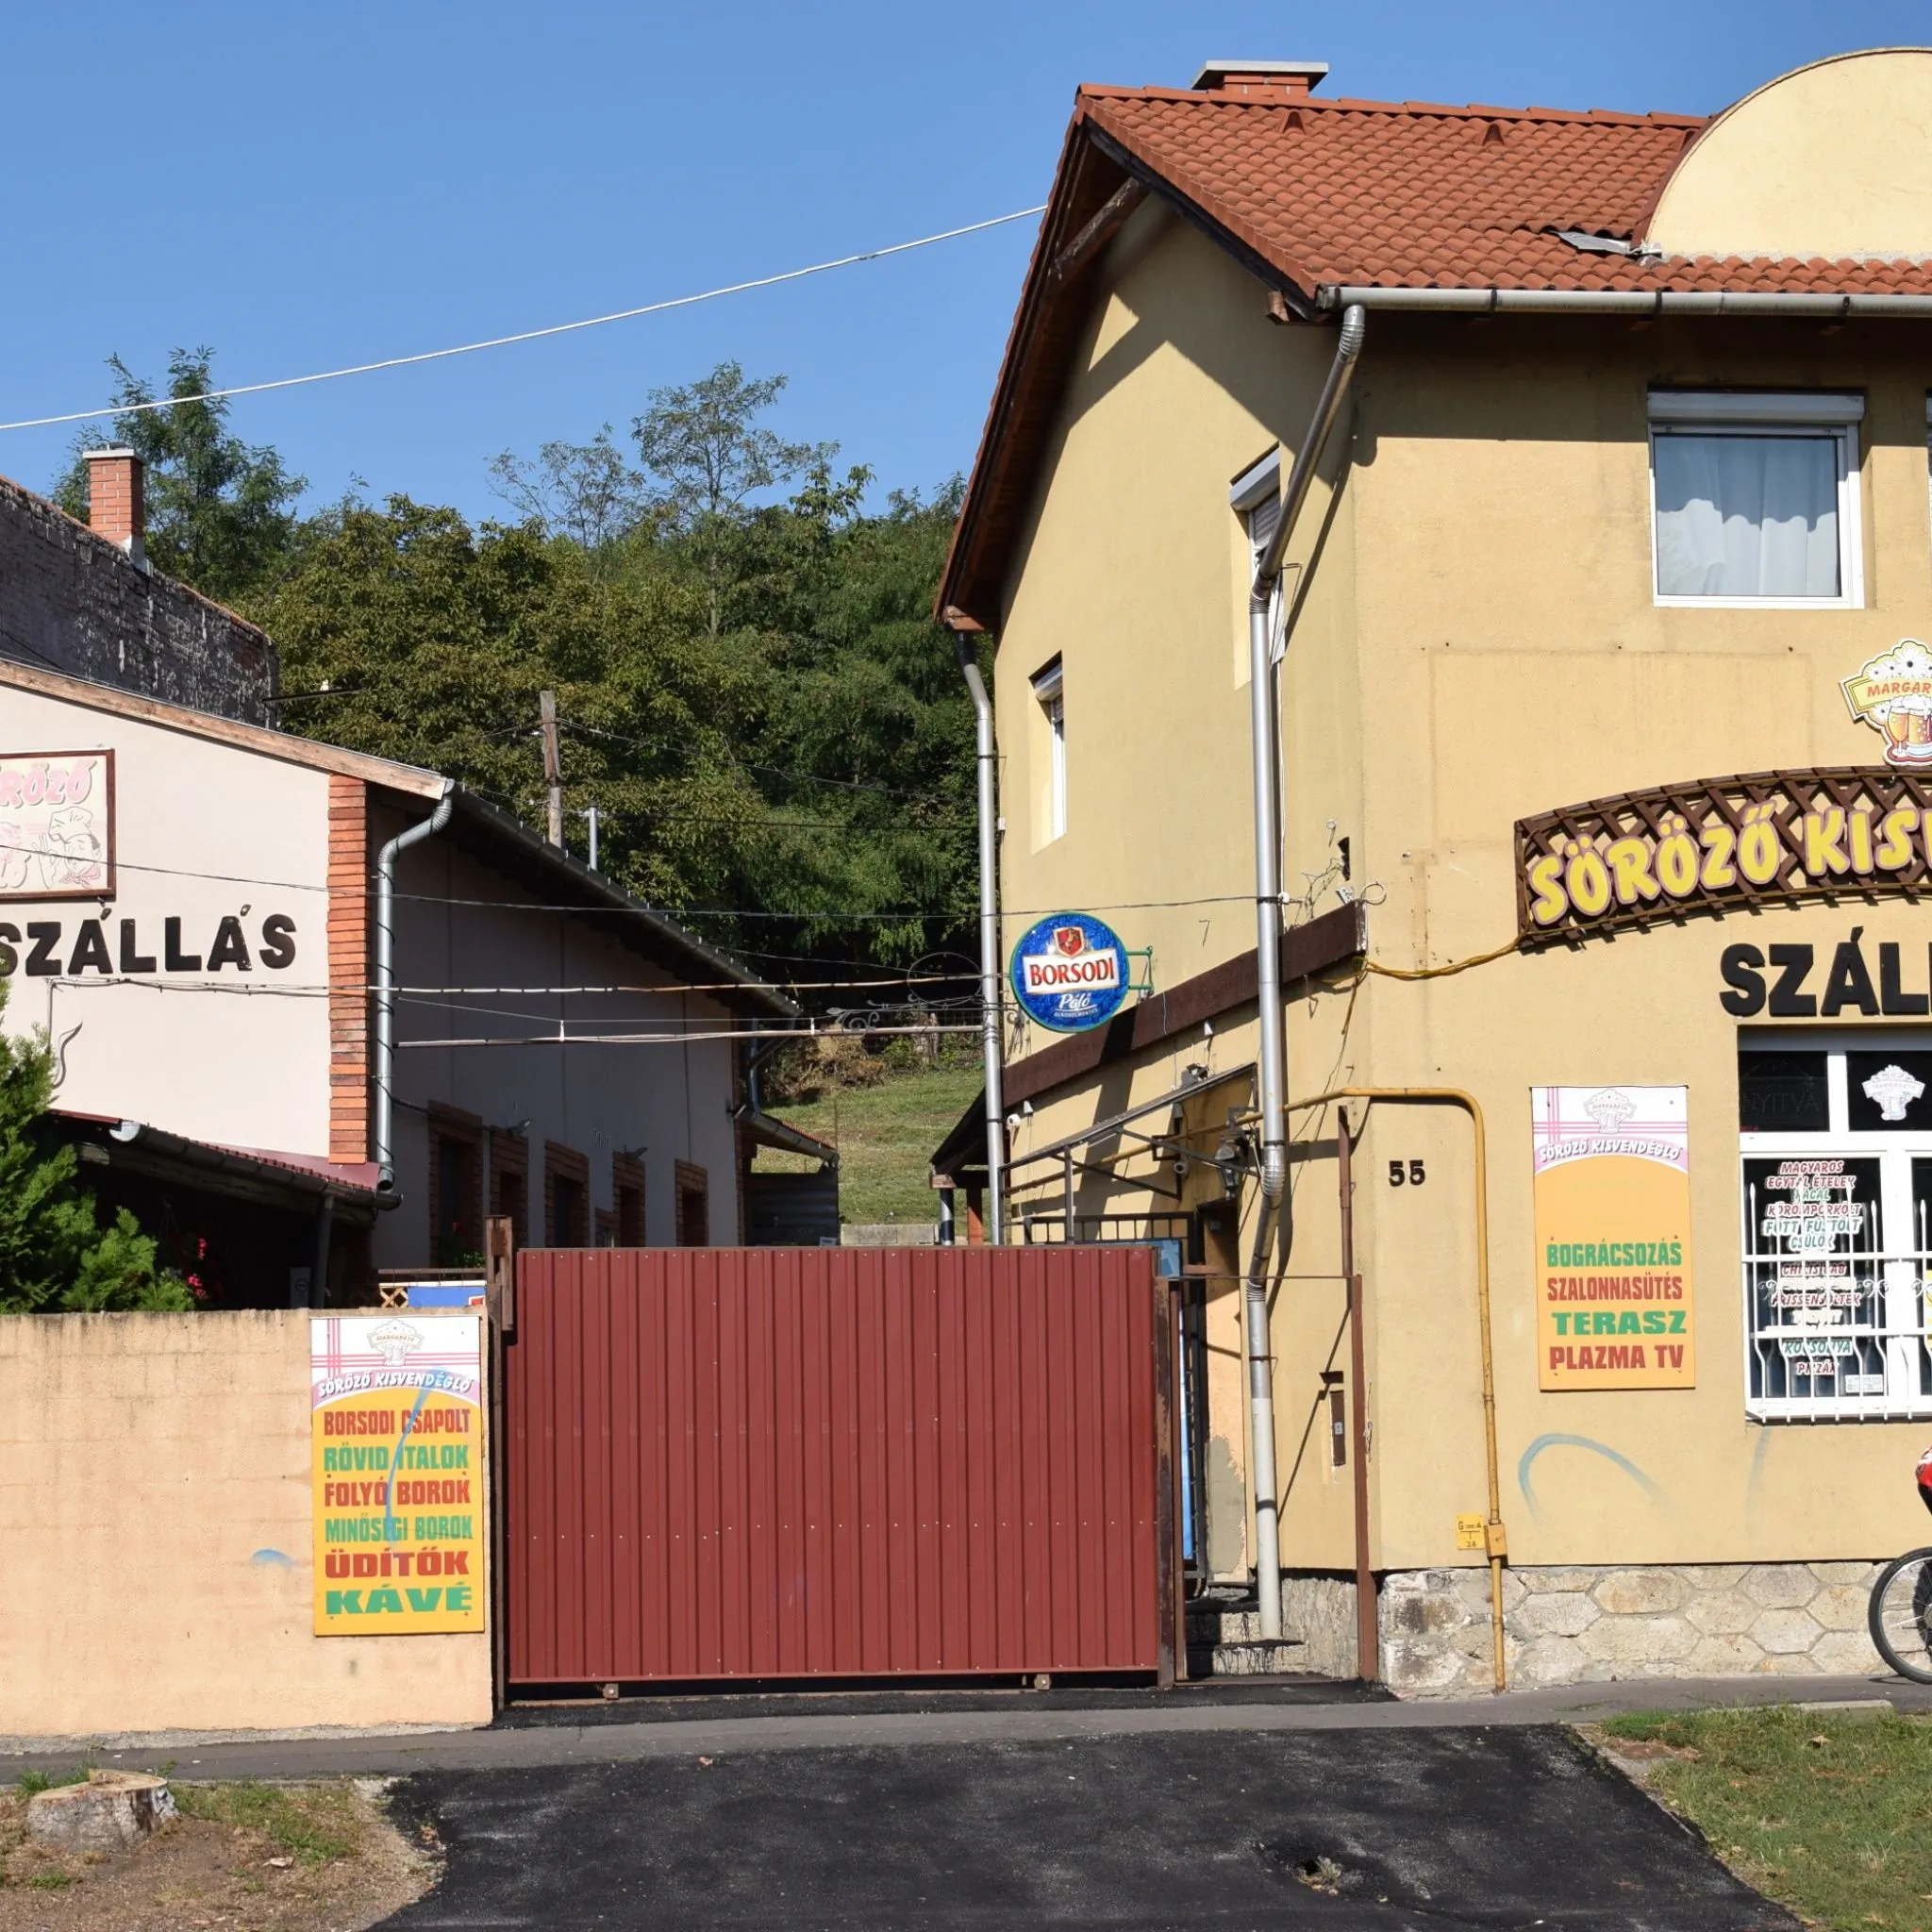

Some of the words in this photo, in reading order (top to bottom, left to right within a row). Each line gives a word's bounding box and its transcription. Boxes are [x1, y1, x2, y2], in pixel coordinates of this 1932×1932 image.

[1527, 799, 1780, 925] SÖRÖZŐ
[1803, 805, 1932, 877] KIS
[0, 904, 297, 976] SZÁLLÁS
[1029, 958, 1115, 987] BORSODI
[1719, 926, 1932, 1018] SZÁL
[1389, 1159, 1425, 1187] 55
[1780, 1161, 1843, 1174] MAGYAROS
[1546, 1238, 1682, 1267] BOGRÁCSOZÁS
[1547, 1272, 1683, 1301] SZALONNASÜTÉS
[1551, 1310, 1687, 1336] TERASZ
[1549, 1345, 1646, 1370] PLAZMA
[1654, 1344, 1684, 1369] TV
[324, 1410, 395, 1436] BORSODI
[401, 1408, 471, 1435] CSAPOLT
[324, 1442, 389, 1472] RÖVID
[397, 1445, 469, 1470] ITALOK
[325, 1476, 390, 1507] FOLYÓ
[396, 1479, 471, 1506] BOROK
[415, 1516, 473, 1541] BOROK
[325, 1546, 469, 1578] ÜDÍTŐK
[325, 1582, 473, 1615] KÁVÉ
